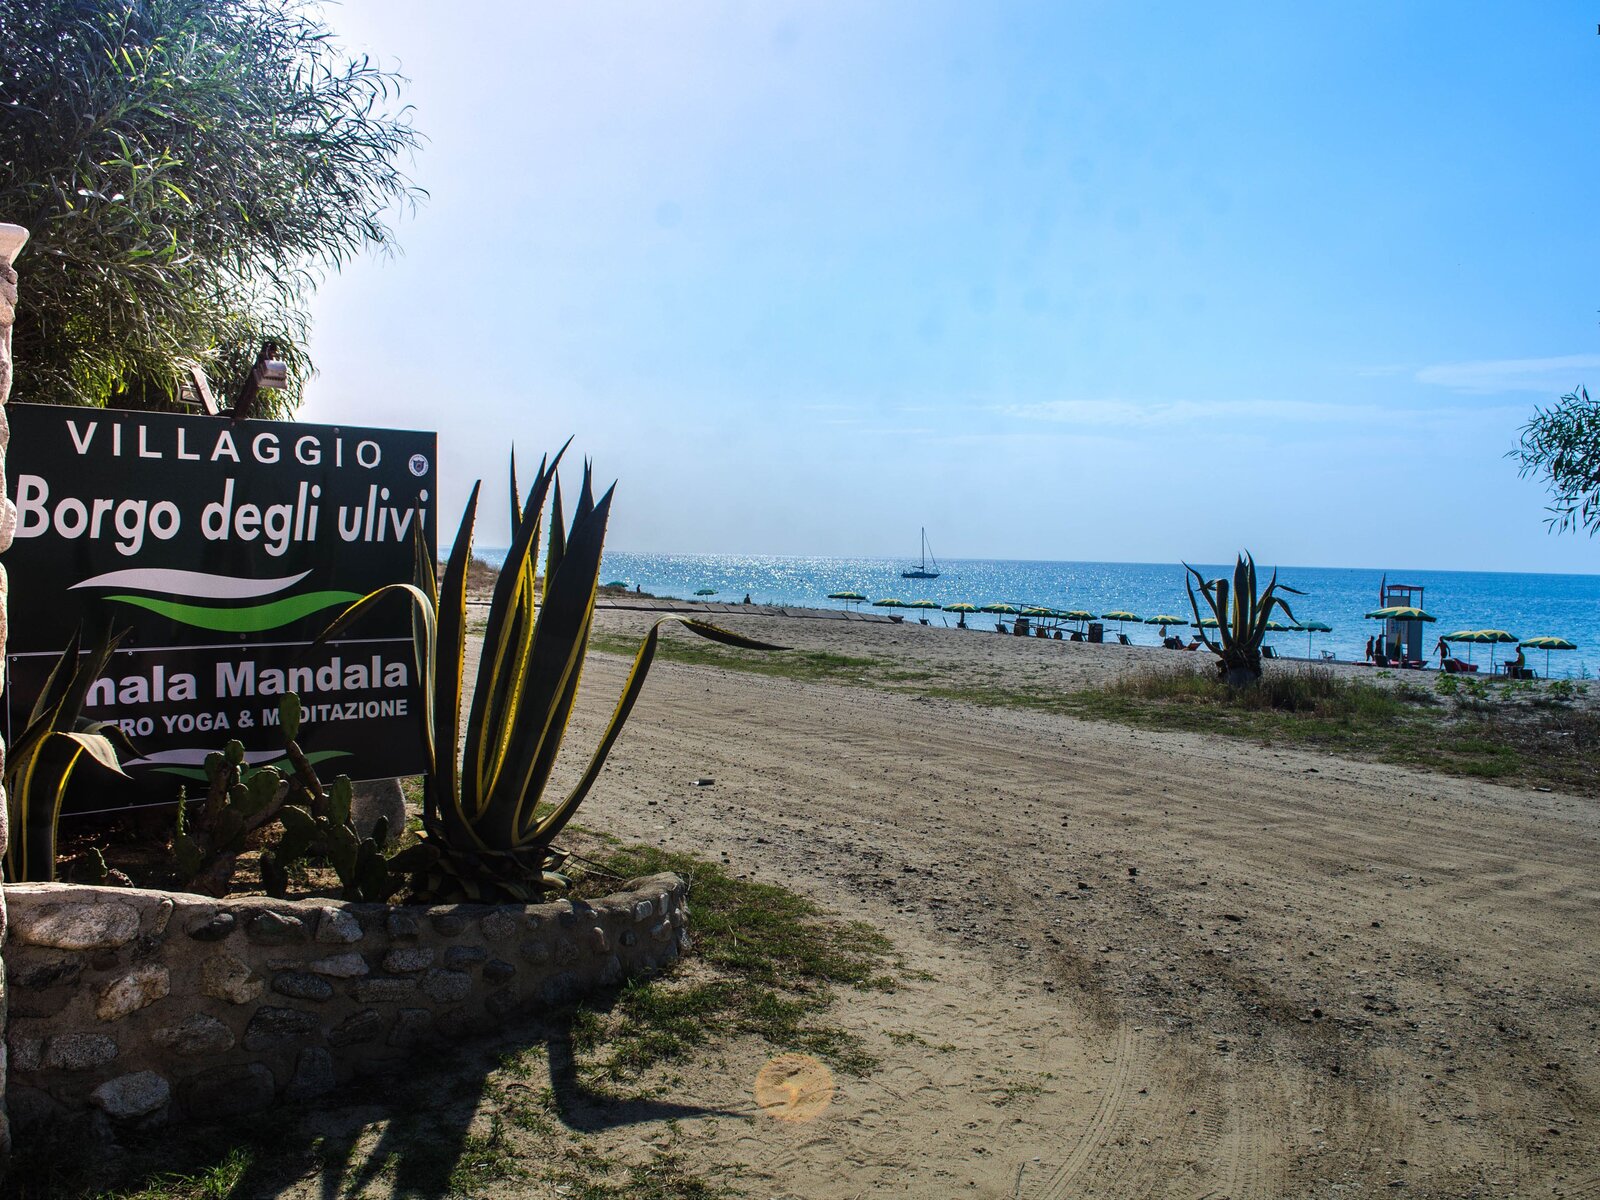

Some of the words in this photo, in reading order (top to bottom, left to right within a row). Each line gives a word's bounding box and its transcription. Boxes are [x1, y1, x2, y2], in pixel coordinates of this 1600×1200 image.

[66, 420, 382, 469] VILLAGGIO
[14, 474, 181, 556] Borgo
[201, 478, 321, 557] degli
[338, 484, 429, 542] ulivi
[216, 655, 409, 698] Mandala
[161, 711, 231, 734] YOGA
[237, 710, 254, 728] &
[262, 699, 408, 726] MDITAZIONE
